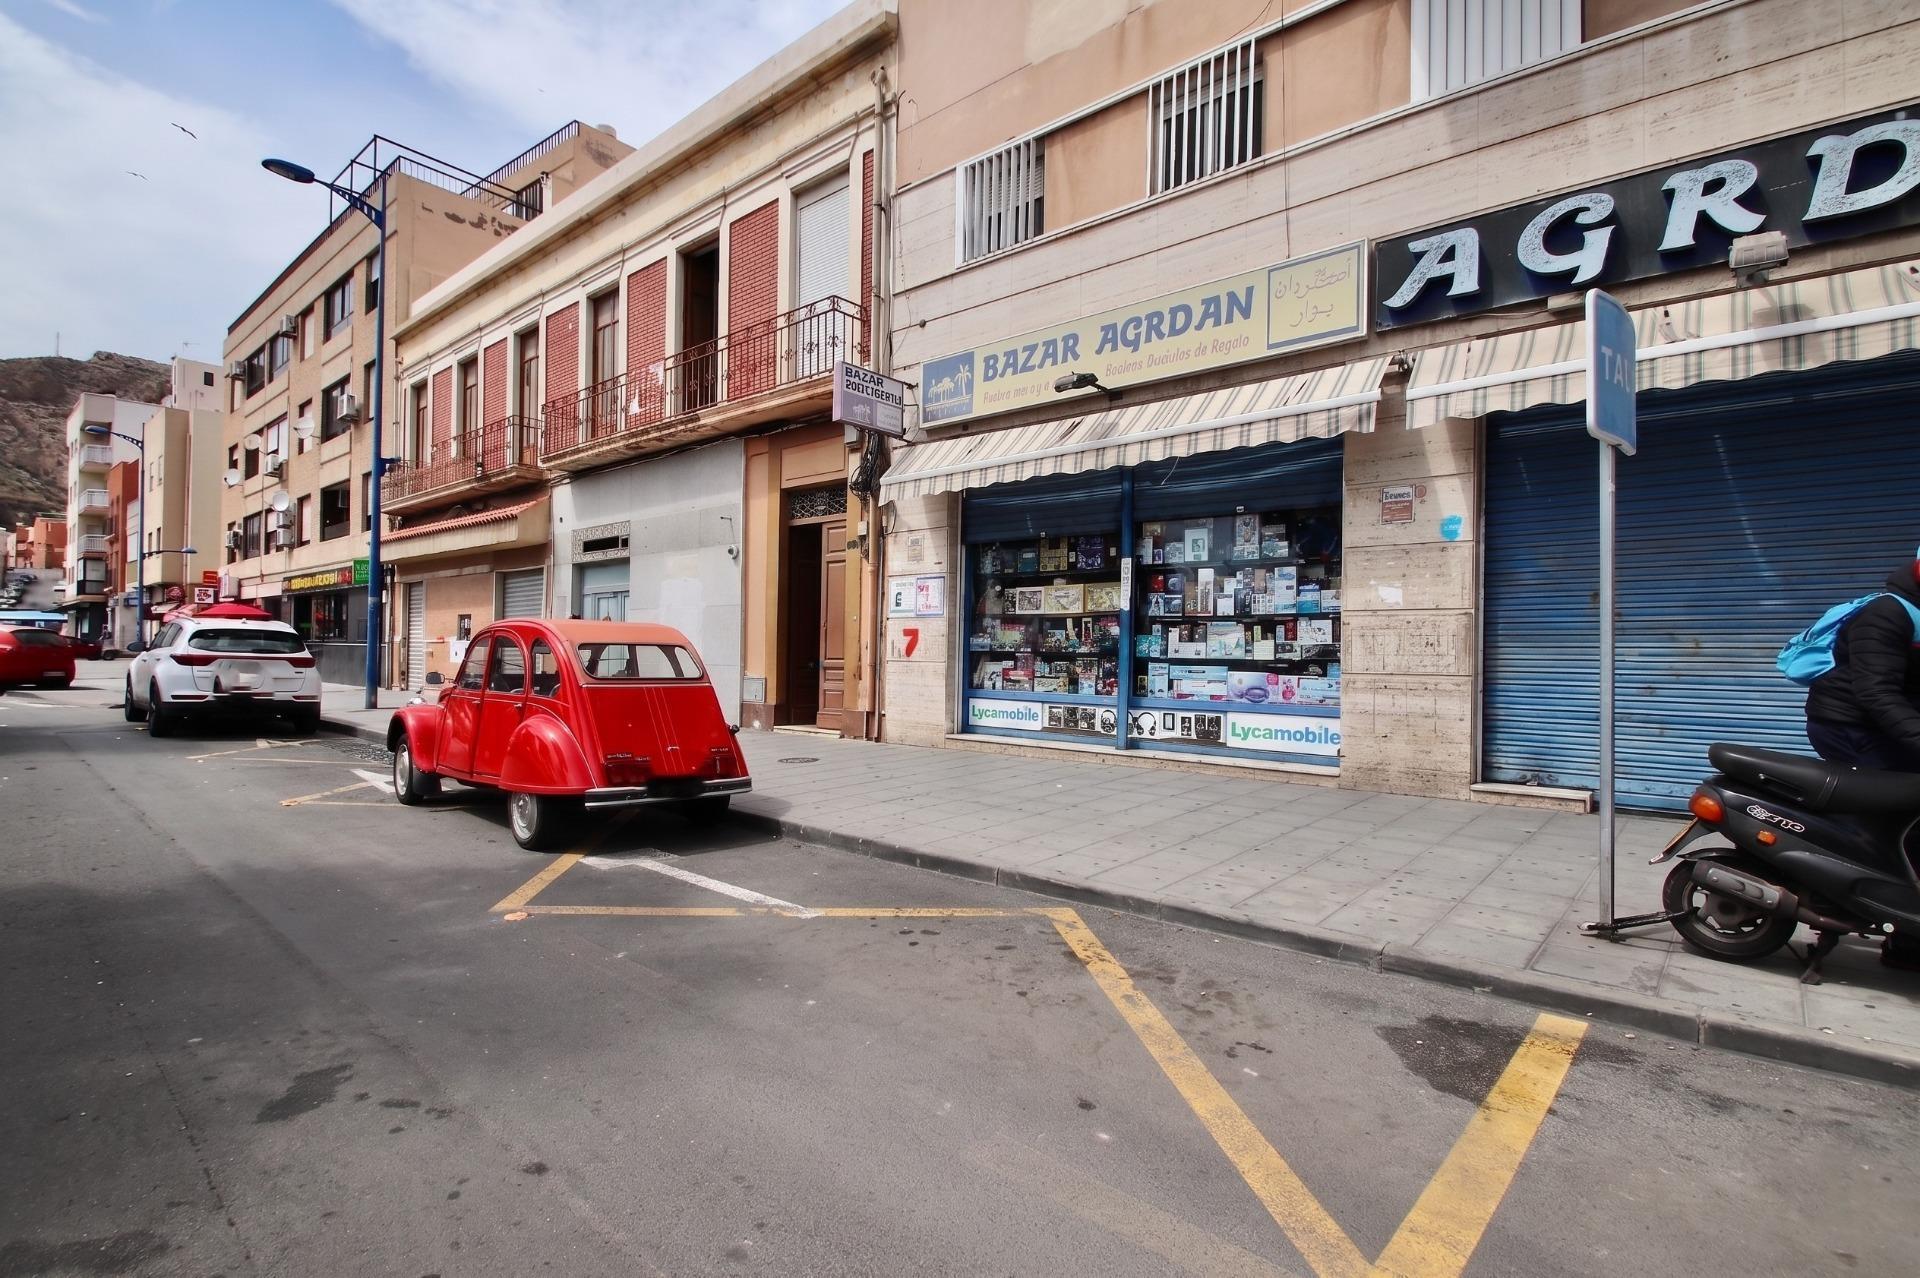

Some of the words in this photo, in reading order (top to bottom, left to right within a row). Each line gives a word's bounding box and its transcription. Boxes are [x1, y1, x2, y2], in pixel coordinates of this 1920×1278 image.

[983, 332, 1081, 382] BAZAR
[1094, 285, 1255, 355] AGRDAN
[1210, 334, 1249, 355] Regalo
[845, 366, 884, 388] BAZAR
[971, 705, 1039, 722] Lycamobile
[1231, 721, 1341, 745] Lycamobile
